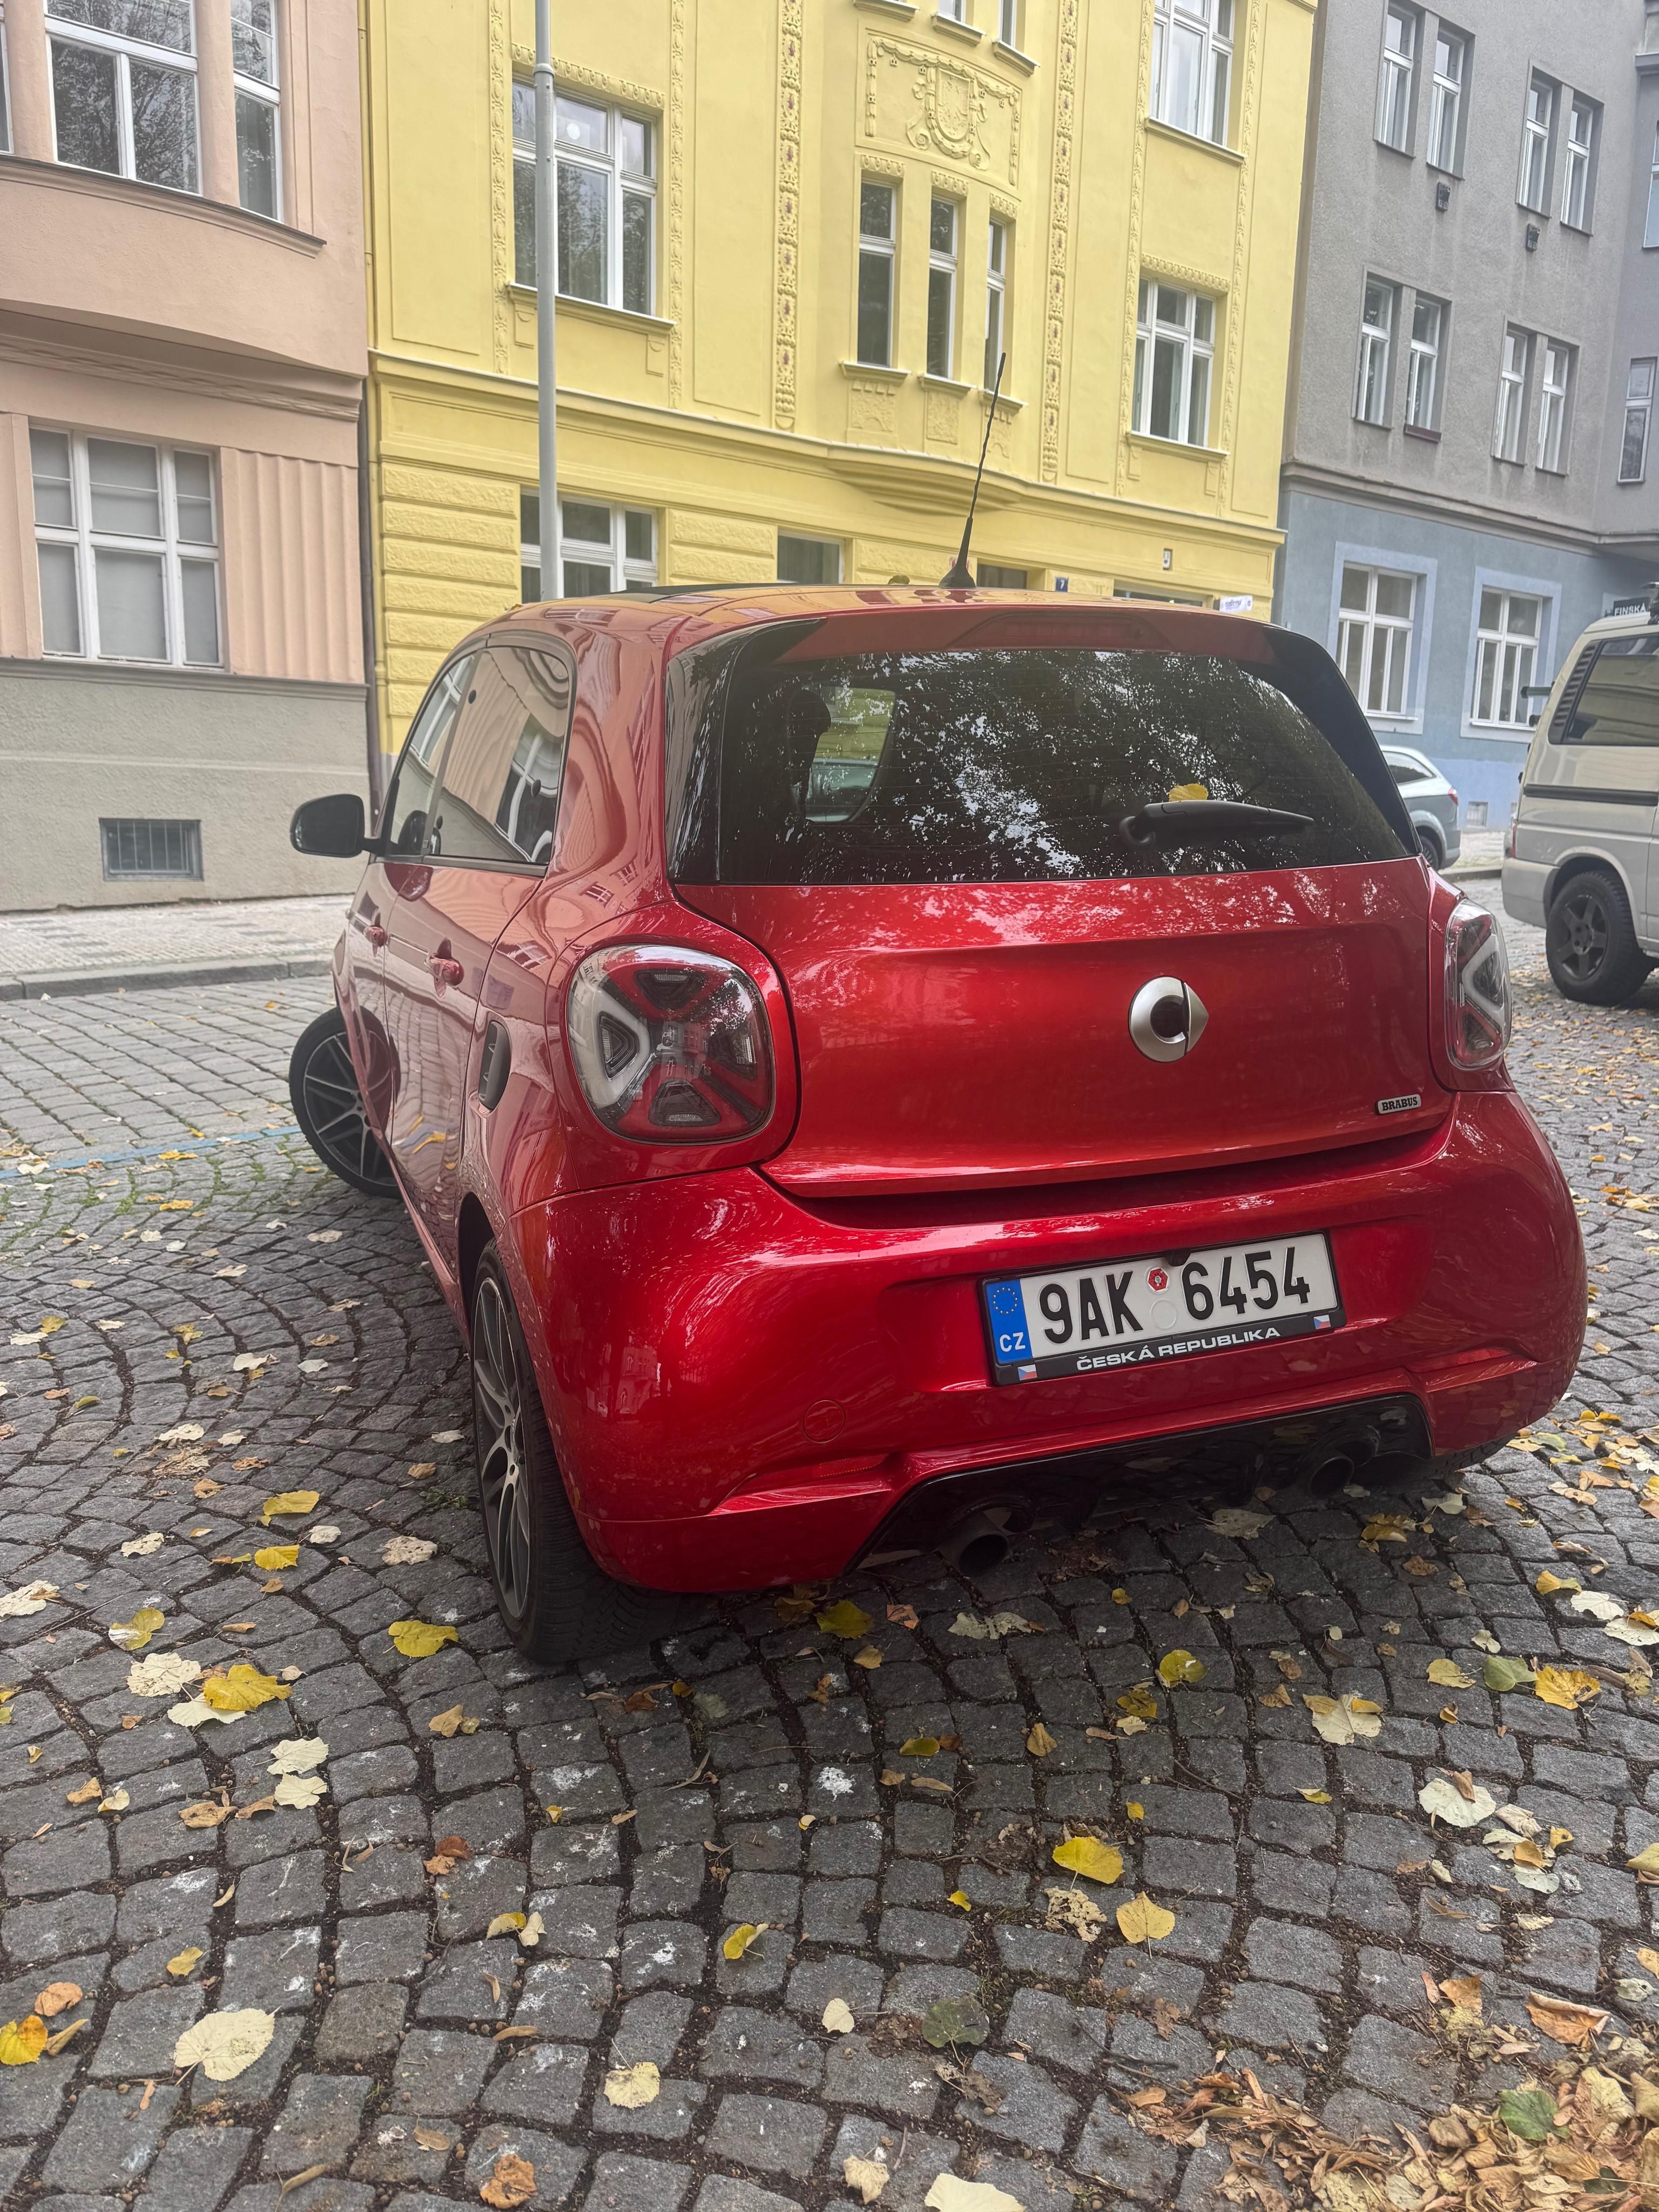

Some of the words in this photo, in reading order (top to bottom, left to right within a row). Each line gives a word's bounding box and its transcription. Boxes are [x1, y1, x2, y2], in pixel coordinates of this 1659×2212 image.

[1060, 579, 1065, 589] 7
[1381, 1097, 1418, 1111] BRABUS
[1038, 1270, 1144, 1344] 9AK
[1181, 1246, 1310, 1320] 6454
[999, 1332, 1026, 1352] CZ
[1076, 1344, 1155, 1371] ČESKÁ
[1158, 1327, 1281, 1357] REPUBLIKA
